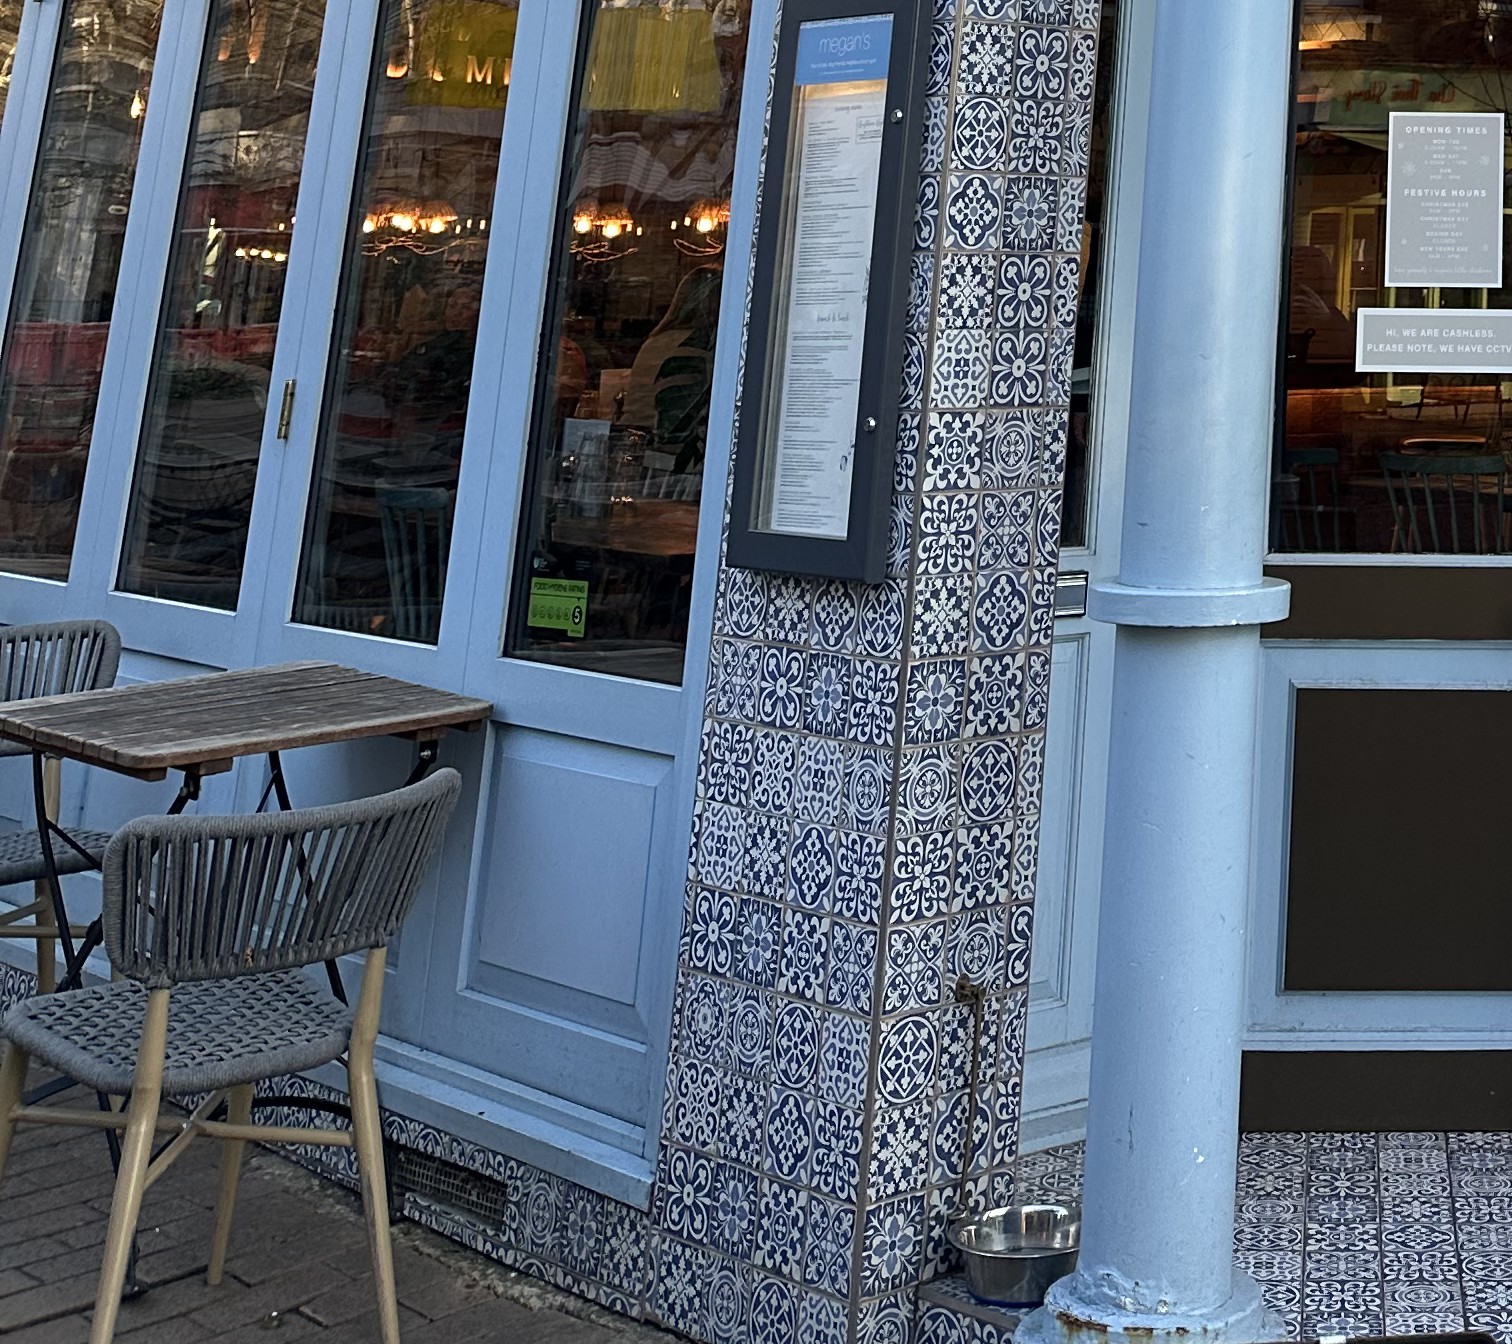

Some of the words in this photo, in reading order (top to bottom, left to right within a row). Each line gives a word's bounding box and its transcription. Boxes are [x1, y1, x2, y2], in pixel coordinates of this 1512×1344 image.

[818, 31, 872, 58] megan's
[1405, 125, 1452, 135] OPENING
[1455, 126, 1488, 136] TIMES
[1403, 188, 1447, 197] FESTIVE
[1451, 188, 1488, 198] HOURS
[1402, 328, 1417, 337] WE
[1419, 328, 1440, 338] ARE
[1366, 343, 1404, 352] PLEASE
[1439, 344, 1455, 353] WE
[1457, 344, 1483, 353] HAVE
[573, 608, 581, 623] 5
